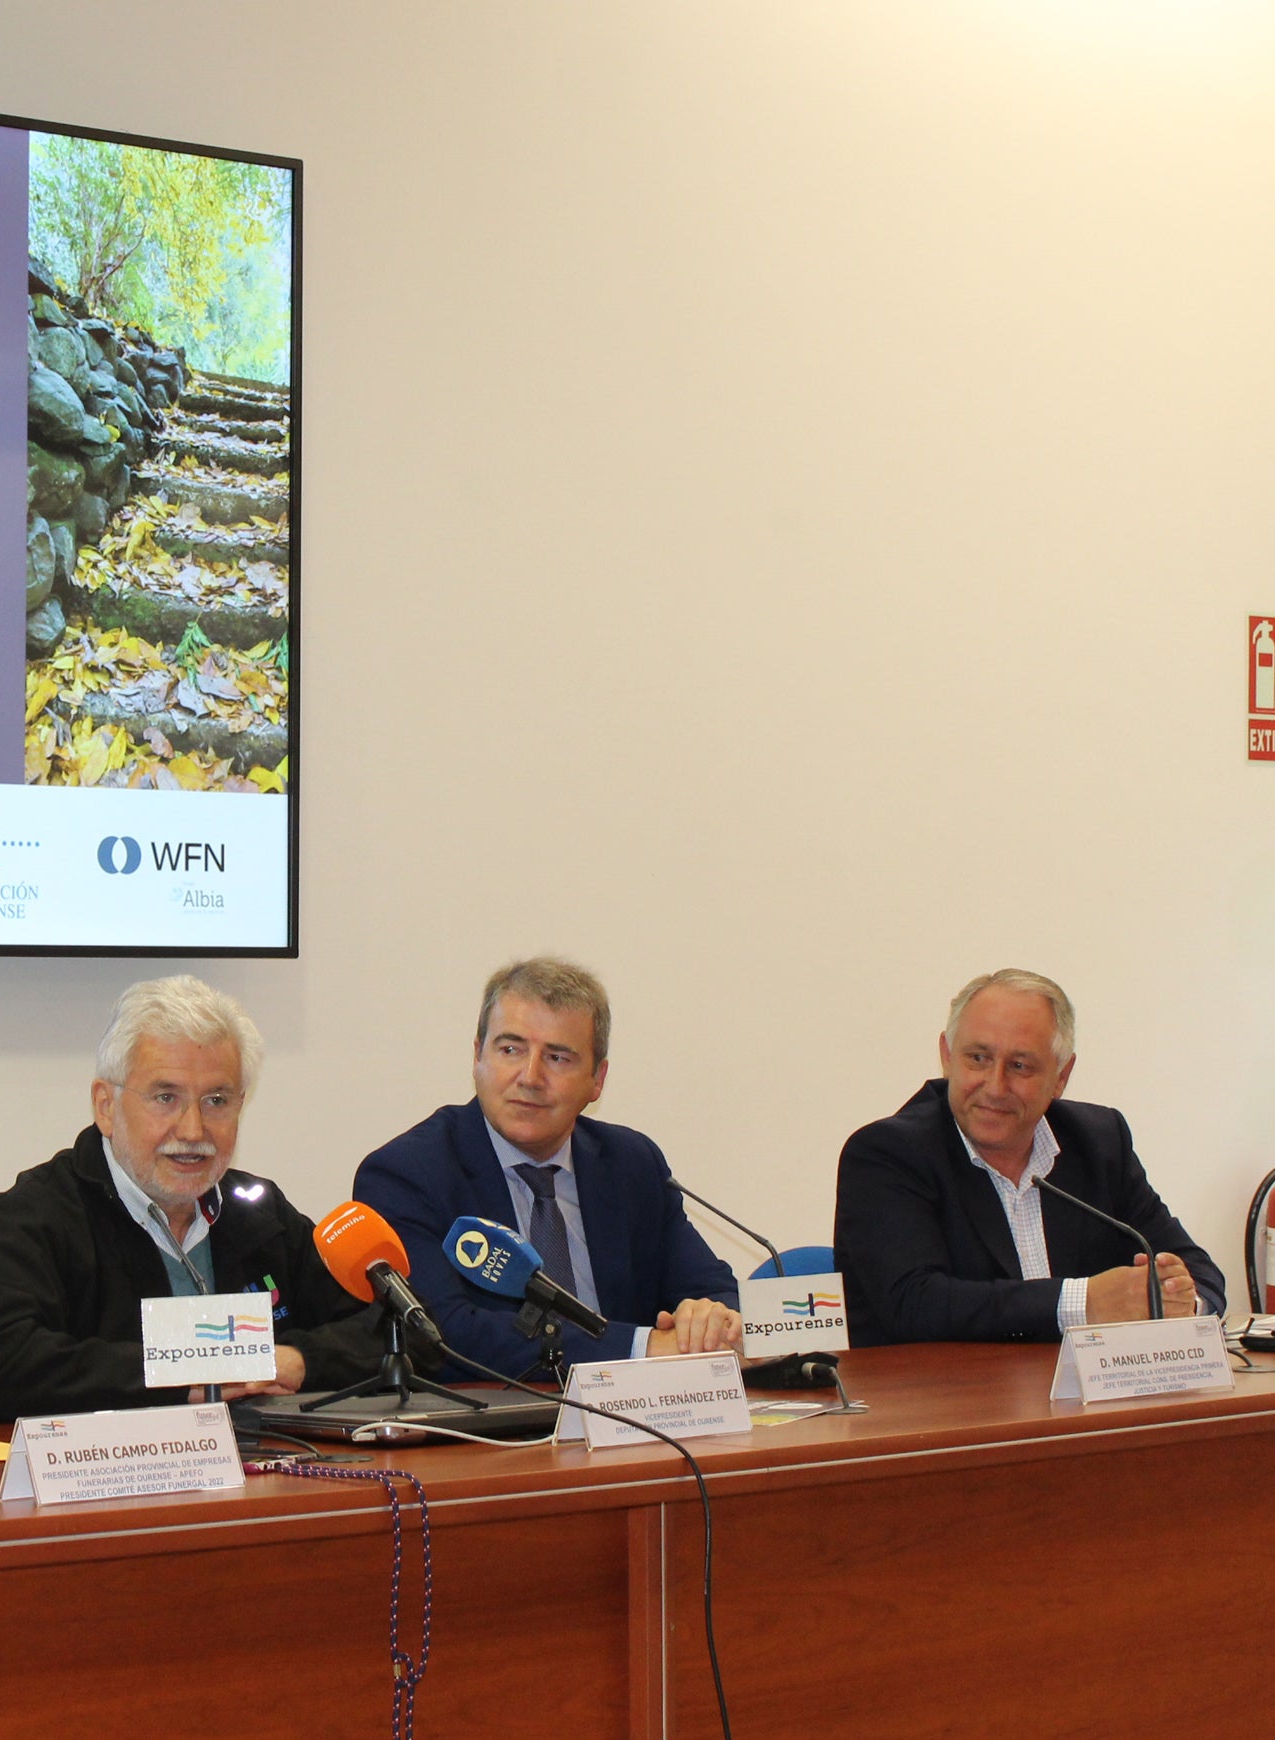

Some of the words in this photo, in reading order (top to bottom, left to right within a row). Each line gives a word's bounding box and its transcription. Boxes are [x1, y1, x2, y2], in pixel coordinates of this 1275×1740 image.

[151, 841, 225, 872] WFN
[183, 890, 224, 908] Albia
[481, 1247, 503, 1279] BADAL
[744, 1315, 844, 1336] Expourense
[146, 1342, 271, 1362] Expourense
[1100, 1358, 1110, 1368] D.
[1112, 1353, 1151, 1367] MANUEL
[1153, 1349, 1185, 1362] PARDO
[1187, 1348, 1204, 1358] CID
[599, 1398, 646, 1412] ROSENDO
[649, 1397, 657, 1407] L.
[659, 1390, 714, 1406] FERNÁNDEZ
[716, 1389, 742, 1400] FDEZ.
[644, 1410, 692, 1421] VICEPRESIDENTE
[47, 1452, 61, 1465] D.
[64, 1444, 109, 1463] RUBÉN
[112, 1443, 158, 1459] CAMPO
[161, 1438, 217, 1454] FIDALGO
[42, 1469, 89, 1480] PRESIDENTE
[90, 1463, 135, 1476] ASOCIACIÓN
[137, 1462, 180, 1472] PROVINCIAL
[193, 1456, 232, 1466] EMPRESAS
[77, 1477, 124, 1487] FUNERARIAS
[126, 1475, 136, 1483] DE
[137, 1472, 172, 1482] OURENSE
[179, 1469, 203, 1478] APEFO
[60, 1489, 105, 1500] PRESIDENTE
[137, 1483, 166, 1493] ASESOR
[168, 1480, 207, 1490] FUNERGAL
[208, 1477, 224, 1486] 2022
